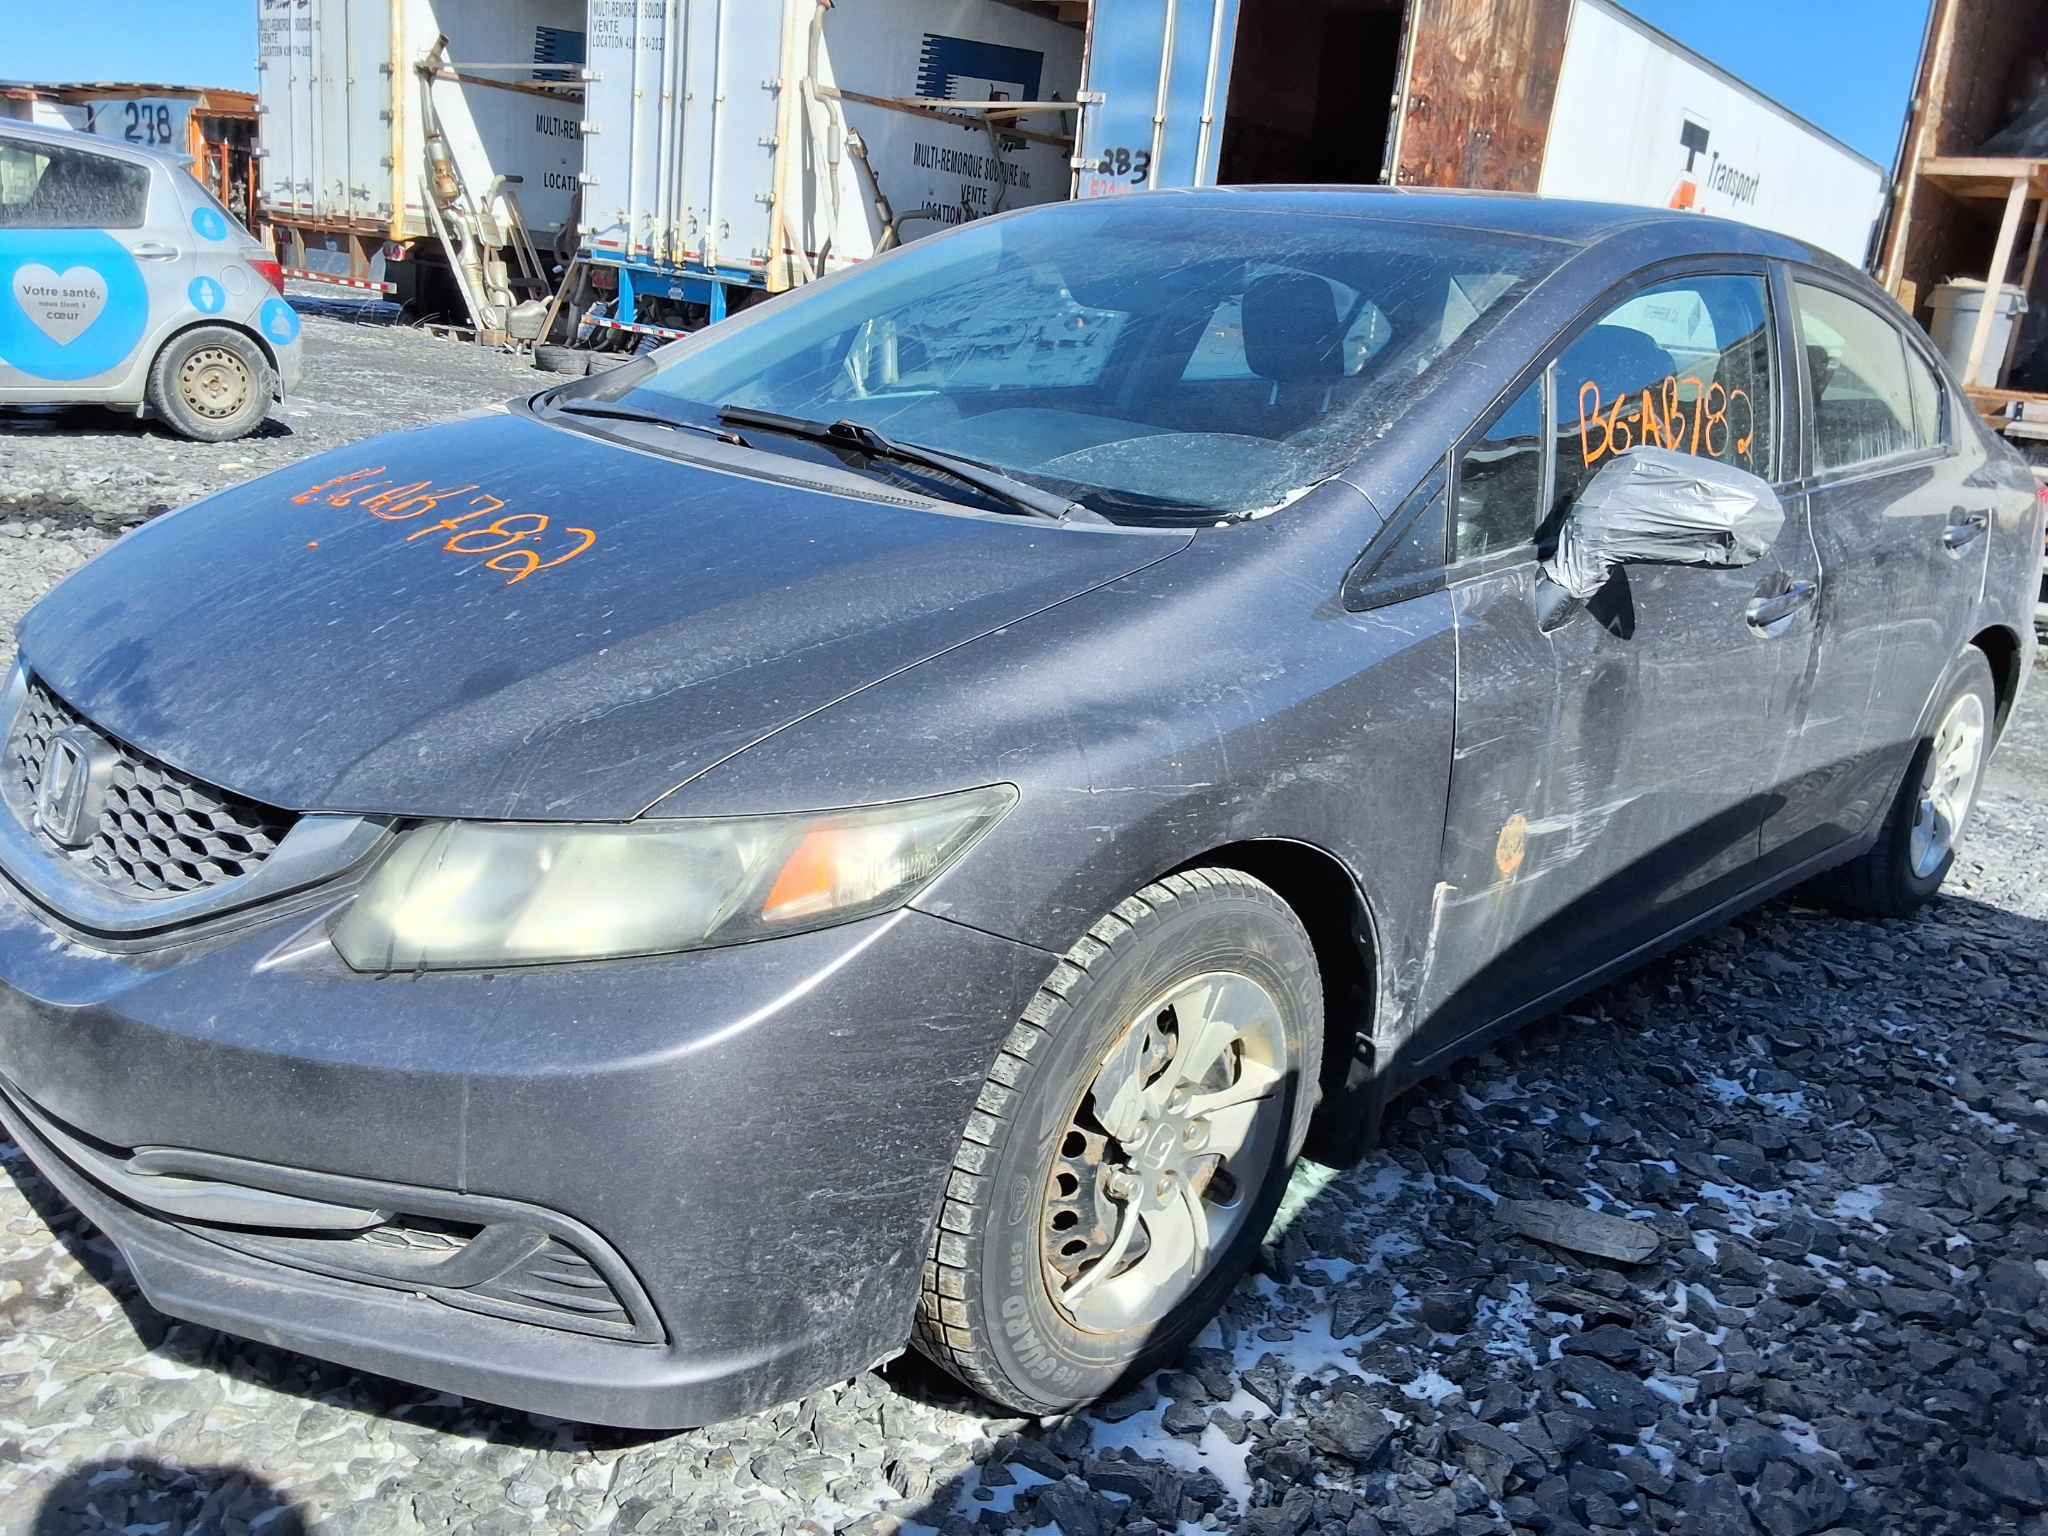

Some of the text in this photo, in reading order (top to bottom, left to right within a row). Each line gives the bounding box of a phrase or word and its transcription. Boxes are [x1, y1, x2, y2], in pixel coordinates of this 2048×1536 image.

[592, 20, 619, 33] VENTE
[592, 34, 624, 49] LOCATION
[124, 102, 172, 146] 278
[912, 141, 983, 180] MULTI-REMORQUE
[1706, 151, 1761, 207] Transport
[961, 183, 988, 205] VENTE
[22, 285, 101, 300] Votre santé,
[46, 311, 80, 321] cœur
